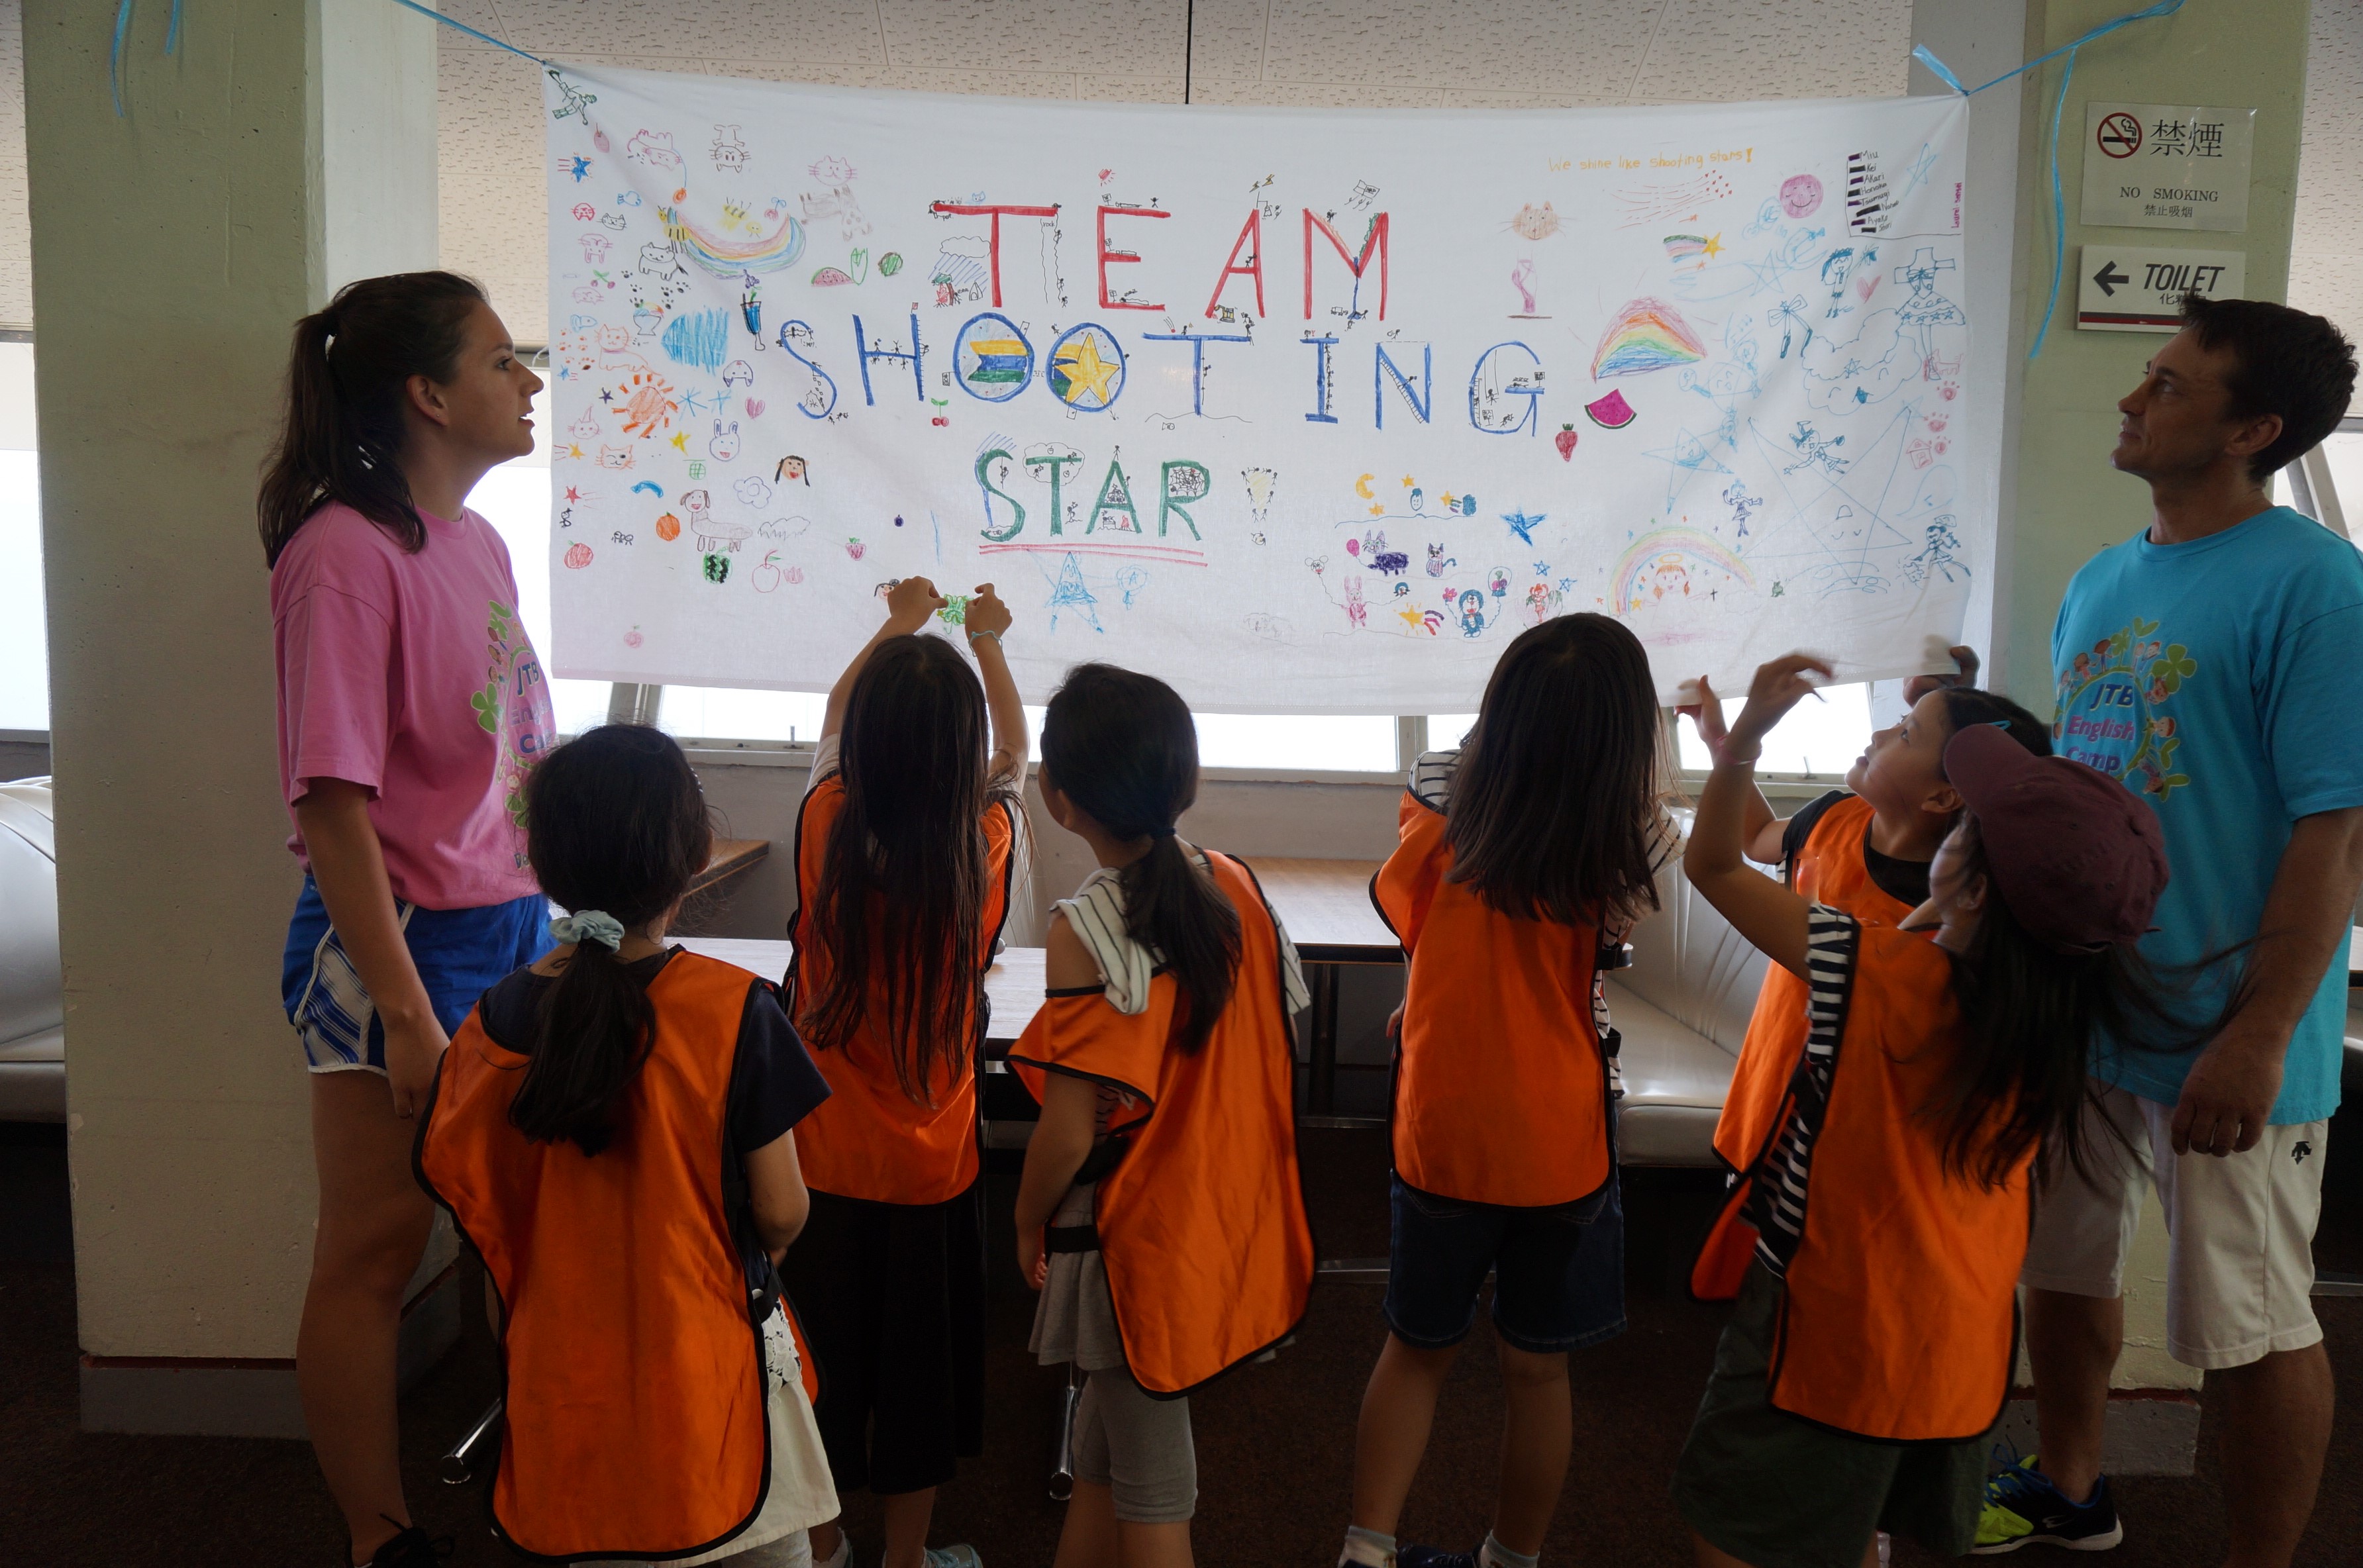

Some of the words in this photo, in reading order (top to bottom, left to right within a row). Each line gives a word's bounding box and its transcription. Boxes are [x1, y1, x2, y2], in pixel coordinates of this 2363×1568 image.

[2149, 118, 2225, 158] 禁煙
[1548, 156, 1571, 172] We
[1580, 158, 1611, 170] shine
[1619, 155, 1640, 170] like
[1860, 150, 1879, 162] Miu
[1866, 163, 1877, 172] Kei
[1861, 191, 1889, 206] Tsumugi
[2120, 186, 2140, 199] NO
[2153, 187, 2219, 203] SMOKING
[2144, 203, 2193, 219] 禁止吸烟
[932, 202, 1389, 322] TEAM
[2143, 263, 2226, 293] TOILET
[779, 312, 1545, 438] SHOOTING
[976, 448, 1211, 542] STAR
[517, 661, 540, 697] JTB
[2089, 683, 2134, 710] JTB
[2066, 715, 2135, 742] English
